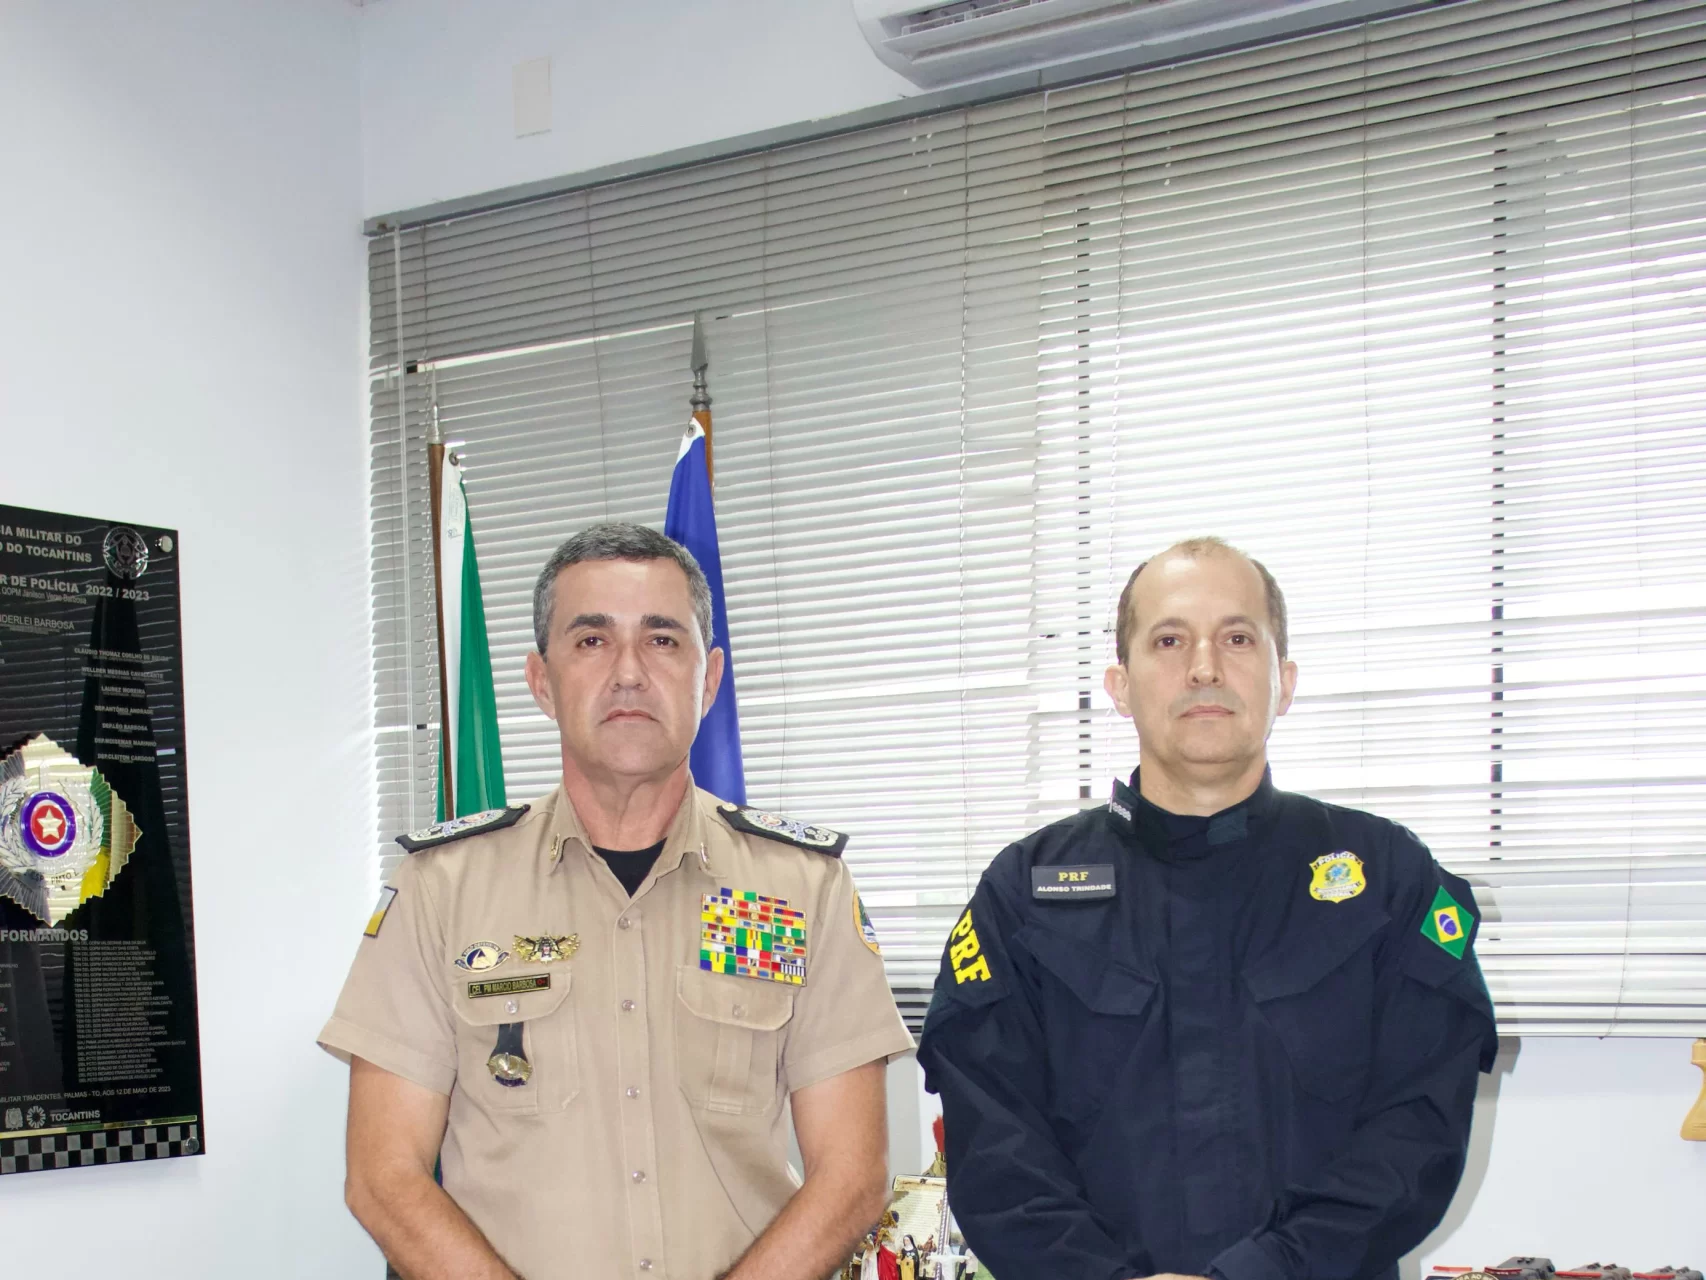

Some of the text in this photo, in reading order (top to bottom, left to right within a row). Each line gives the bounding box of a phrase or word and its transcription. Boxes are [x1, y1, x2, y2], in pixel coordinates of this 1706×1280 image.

[16, 527, 62, 543] MILITAR
[65, 534, 82, 546] DO
[6, 542, 23, 554] DO
[25, 545, 92, 563] TOCANTINS
[11, 575, 27, 587] DE
[30, 579, 79, 593] POLÍCIA
[86, 584, 113, 597] 2022
[122, 589, 150, 601] 2023
[34, 617, 75, 630] BARBOSA
[1058, 871, 1089, 882] PRF
[1037, 884, 1112, 893] ALONSO TRINDADE
[0, 929, 89, 942] FORMANDOS
[950, 908, 992, 985] PRF
[472, 985, 482, 994] CEL
[512, 979, 536, 990] BARBOSA
[50, 1110, 100, 1122] TOCANTINS
